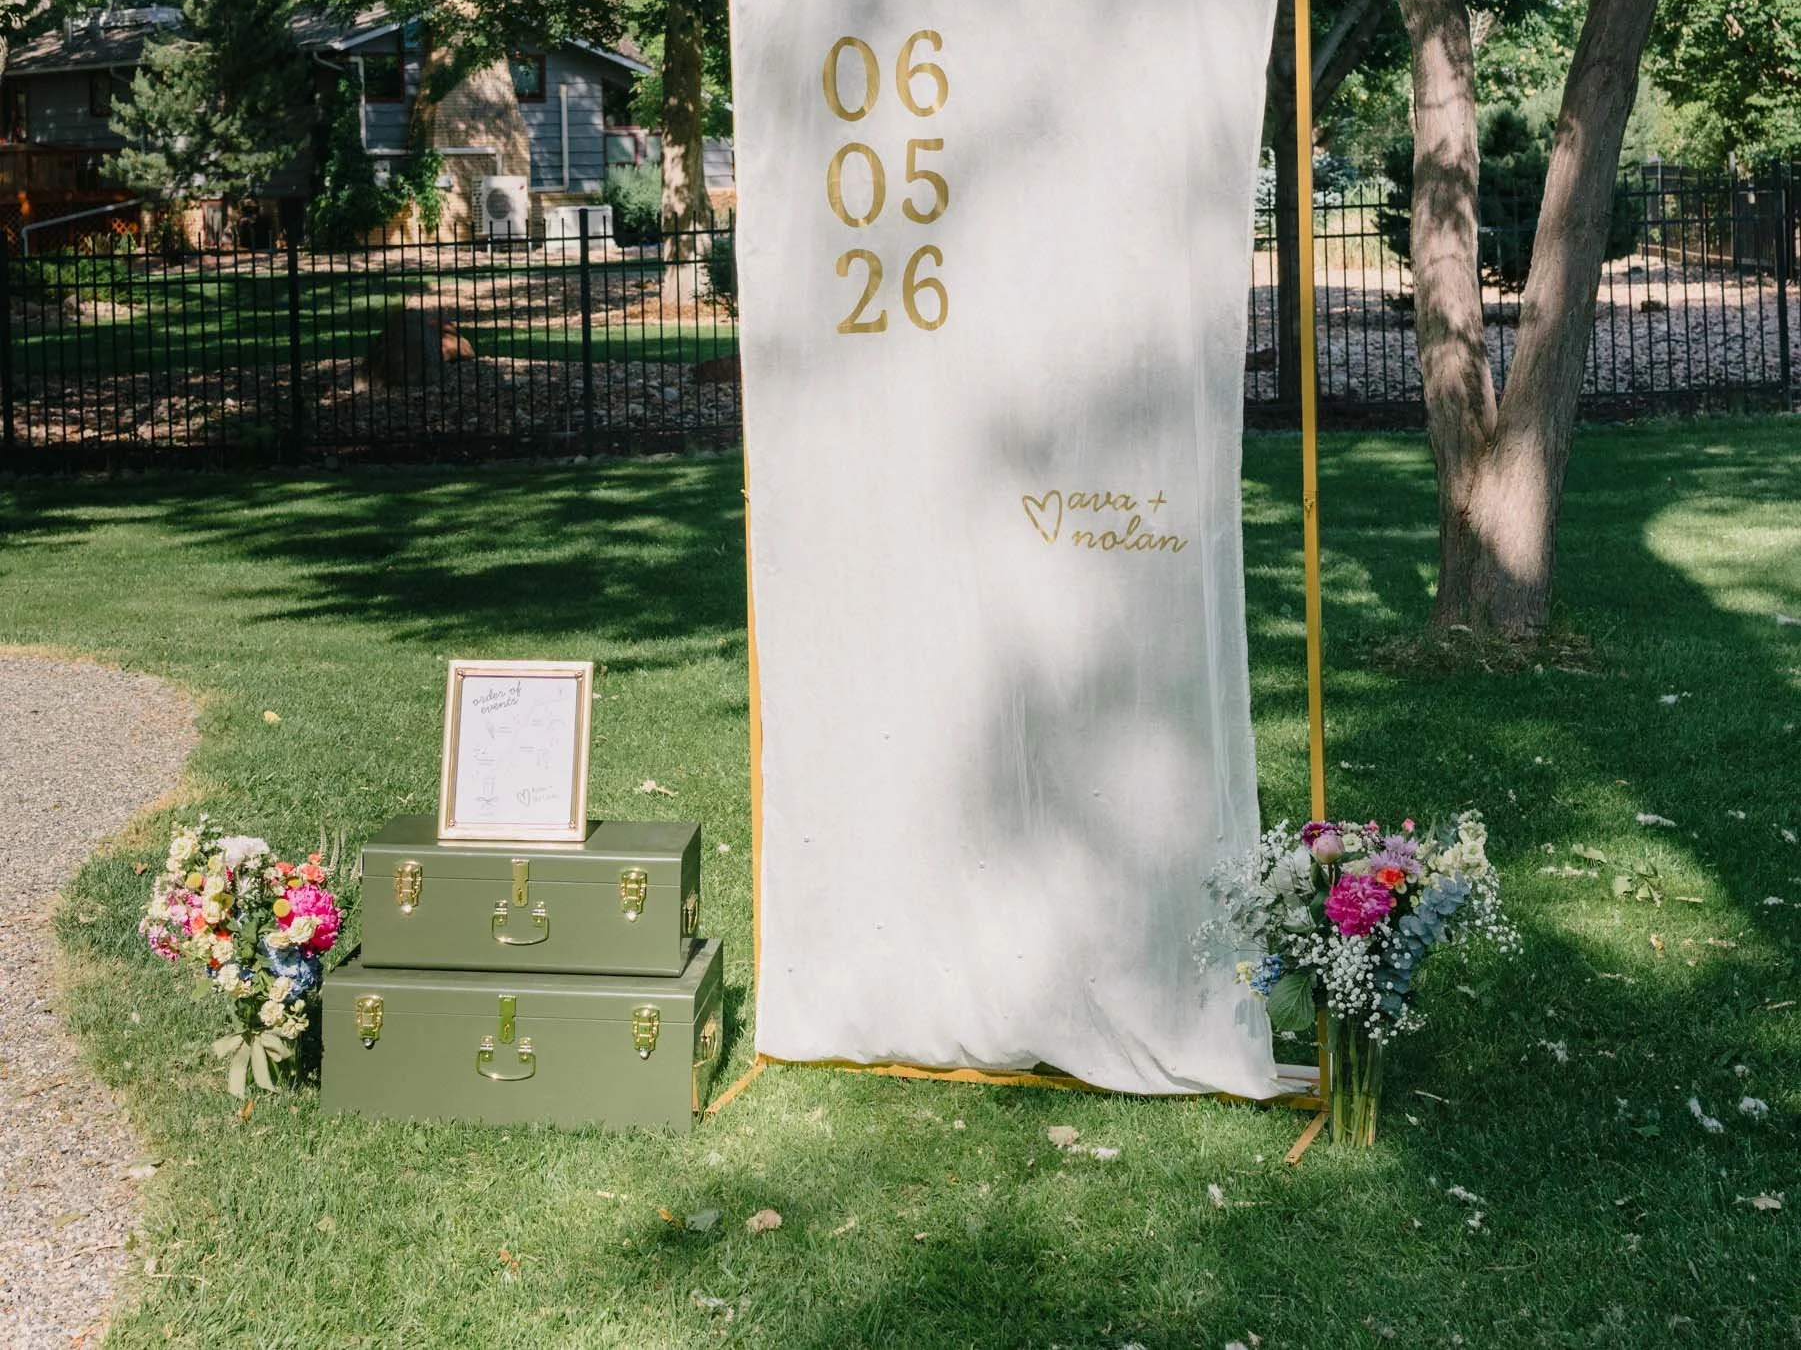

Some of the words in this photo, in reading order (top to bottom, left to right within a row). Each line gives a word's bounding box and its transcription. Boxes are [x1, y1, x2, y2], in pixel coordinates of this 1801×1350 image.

[823, 29, 949, 122] 06
[827, 137, 949, 227] 05
[835, 244, 949, 335] 26
[1067, 490, 1138, 513] ava
[1072, 514, 1190, 554] nolan
[472, 687, 506, 706] order
[509, 680, 522, 698] of
[480, 698, 519, 714] events
